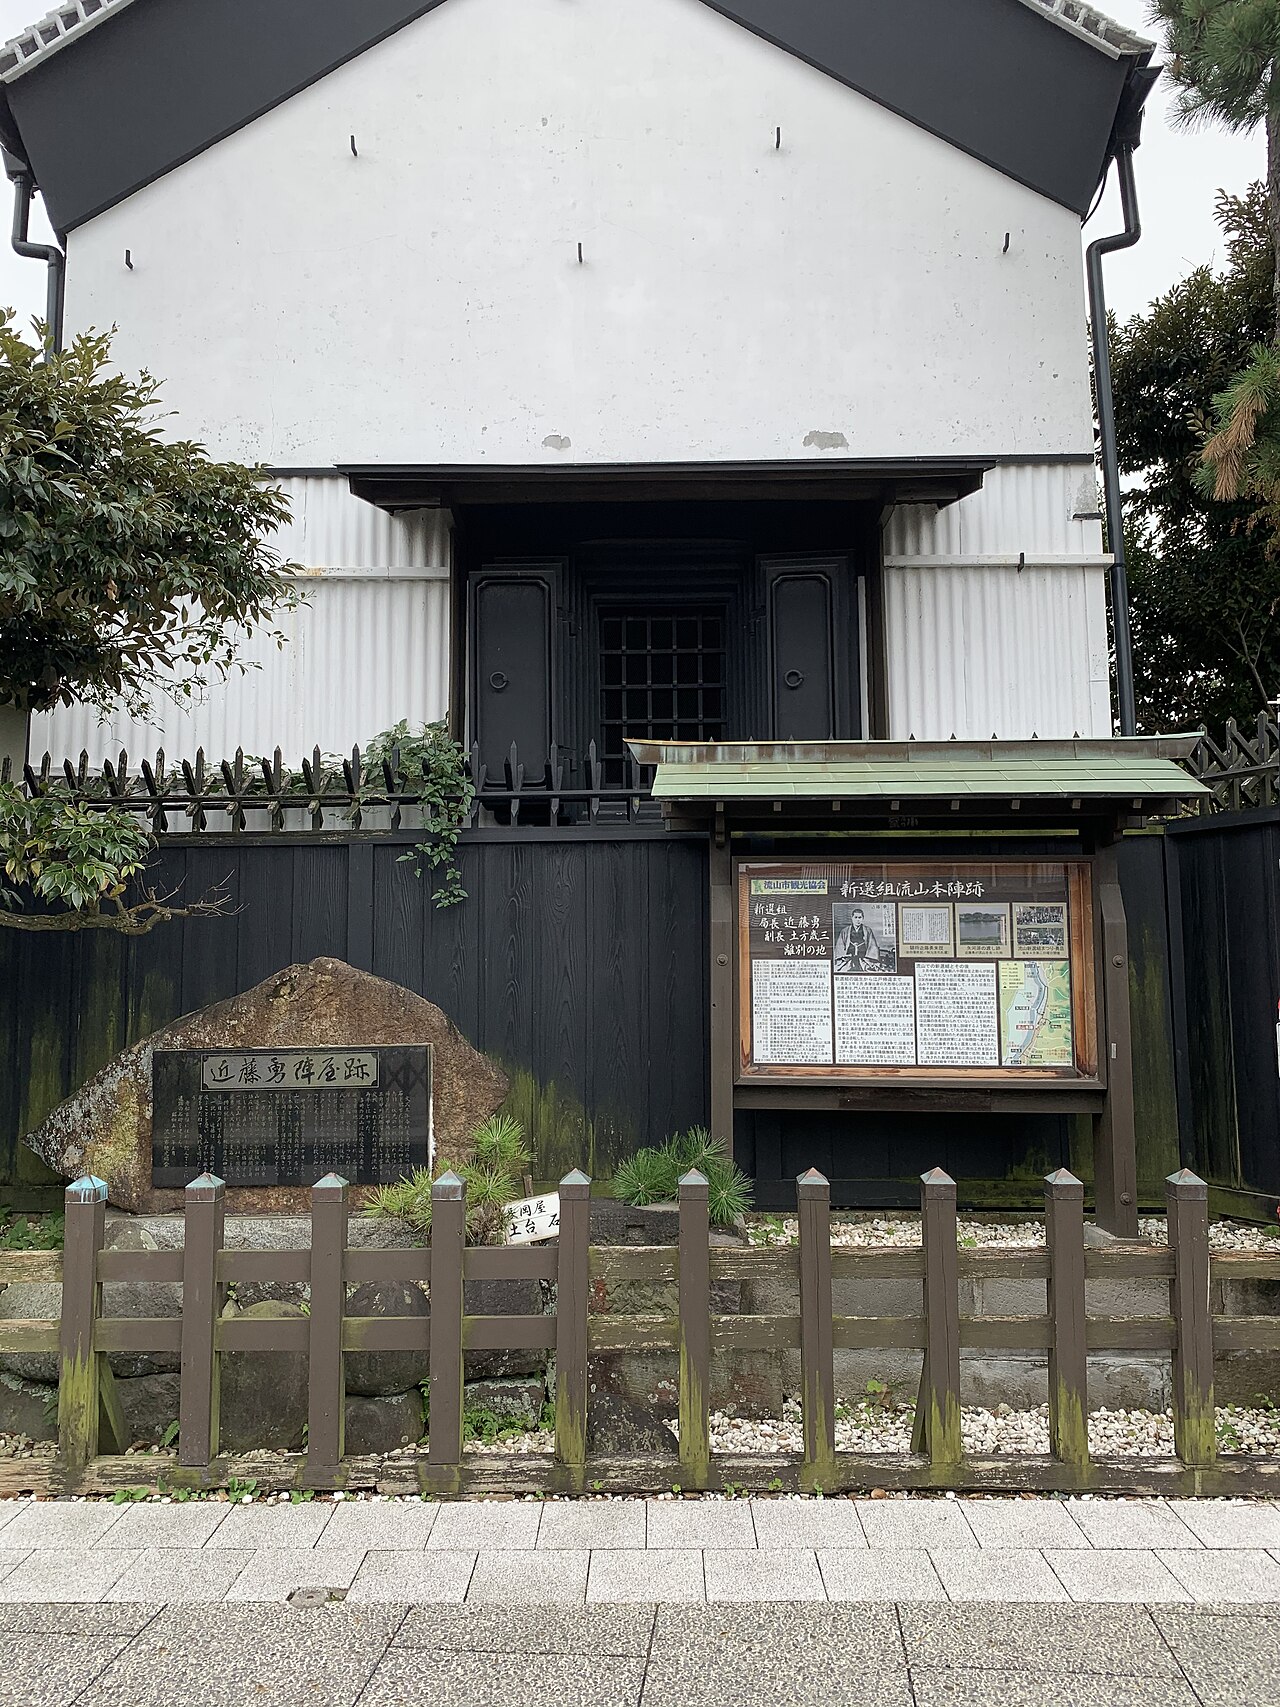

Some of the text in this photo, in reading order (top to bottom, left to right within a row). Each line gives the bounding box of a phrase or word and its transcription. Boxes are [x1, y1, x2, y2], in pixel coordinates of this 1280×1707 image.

[764, 880, 826, 890] 流山市観光協会
[840, 880, 985, 898] 新選組流山本陣跡
[754, 903, 787, 915] 新選組
[759, 916, 820, 929] 局長 近藤勇
[764, 929, 830, 942] 副長 土方歳三
[784, 943, 827, 956] 離別の地
[210, 1057, 371, 1085] 近藤勇陣屋跡
